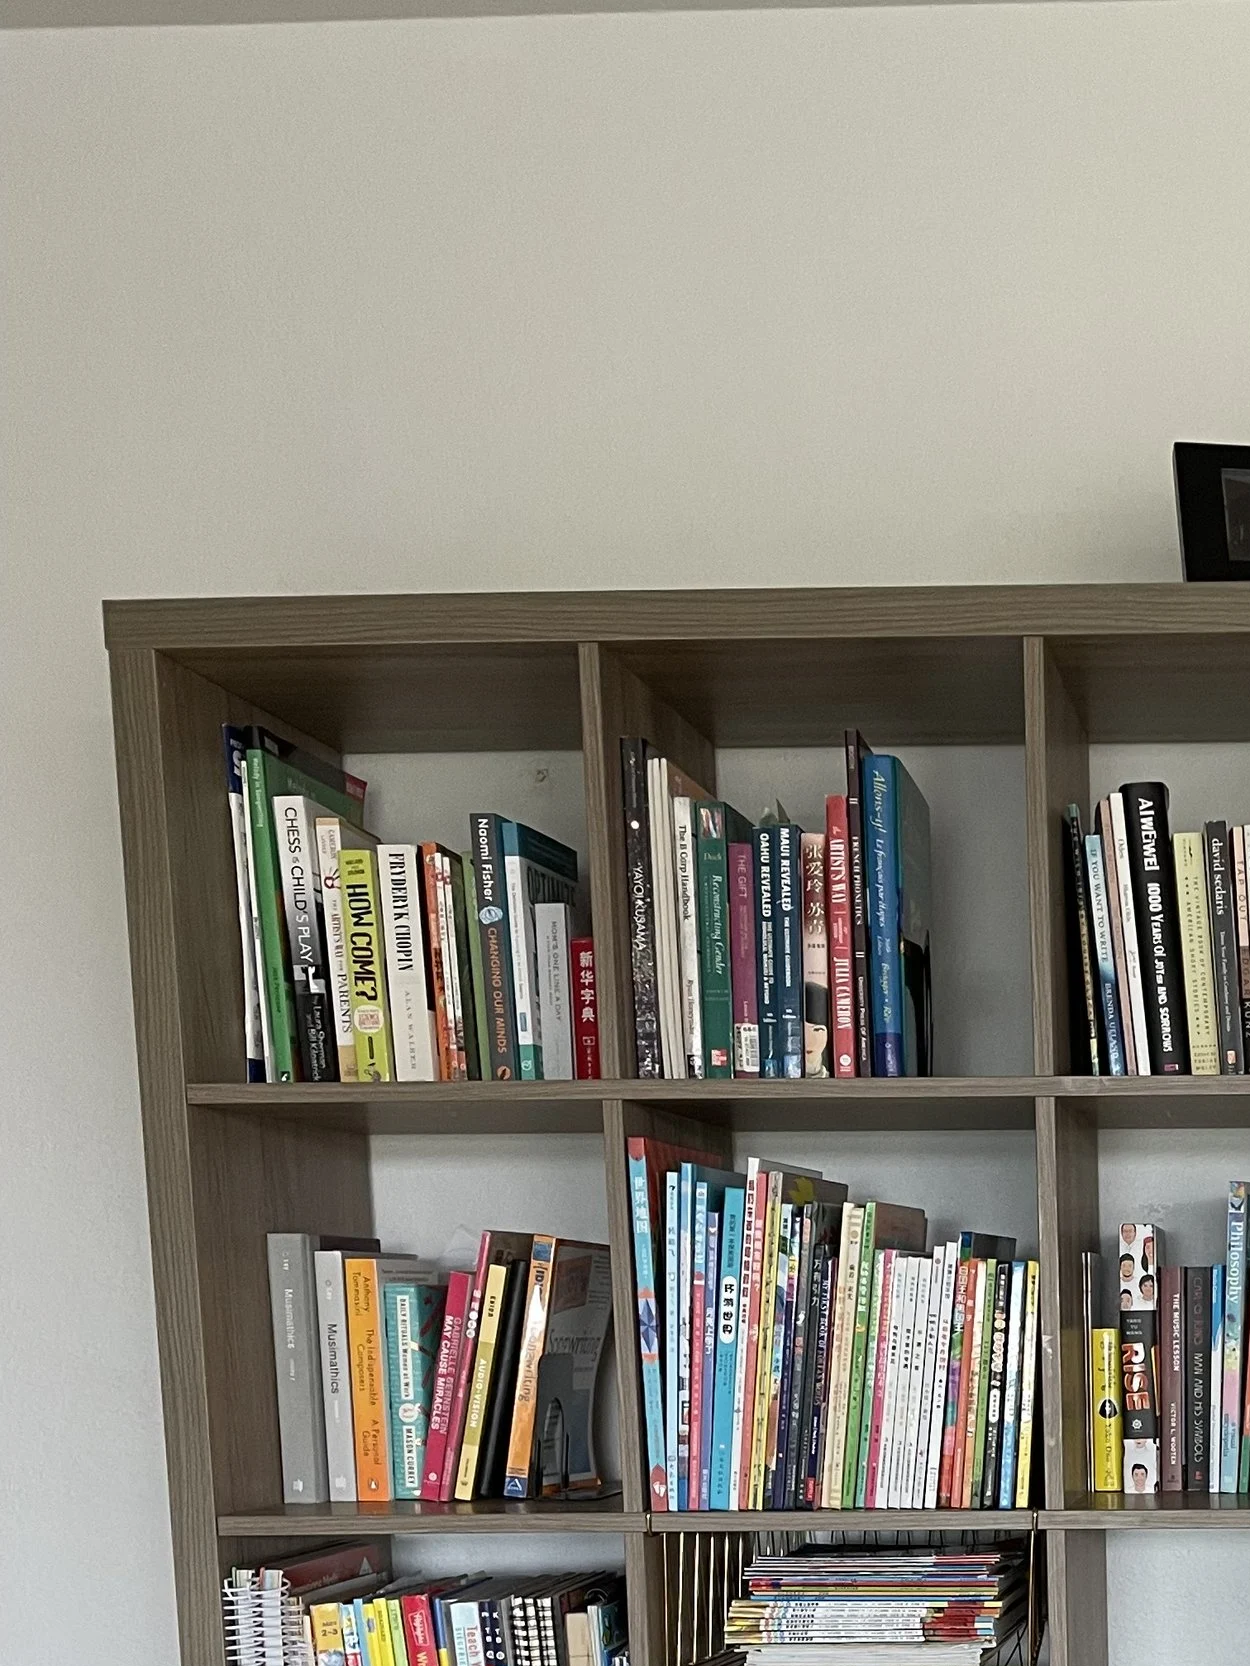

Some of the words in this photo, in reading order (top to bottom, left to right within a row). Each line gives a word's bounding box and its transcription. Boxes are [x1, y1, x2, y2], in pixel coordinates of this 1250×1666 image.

[285, 808, 301, 853] CHESS
[478, 819, 492, 860] Naomi
[760, 833, 770, 863] OAHU
[779, 828, 790, 856] MAUI
[830, 838, 845, 881] ARTIST'S
[1211, 839, 1226, 871] david
[291, 865, 309, 922] CHILD'S
[389, 853, 409, 920] FRYDERYK
[481, 864, 493, 901] Fisher
[761, 866, 771, 917] REVEALED
[781, 859, 793, 911] REVEALED
[832, 884, 846, 903] WAY
[1215, 874, 1227, 915] sedaris
[346, 884, 375, 926] HOW
[298, 926, 314, 962] PLAY
[396, 925, 413, 971] CHOPIN
[487, 928, 500, 987] CHANGING
[351, 932, 377, 1000] COME?
[580, 951, 594, 1022] 新华字典
[834, 957, 850, 982] JULIA
[337, 973, 353, 1033] PARENTS
[493, 991, 504, 1014] OUR
[836, 985, 852, 1029] CAMERON
[496, 1017, 506, 1053] MINDS
[1227, 1221, 1244, 1304] Philosophy
[442, 1315, 453, 1338] MAY
[327, 1324, 340, 1393] Musimathics
[437, 1341, 451, 1375] CAUSE
[1121, 1342, 1150, 1410] RISE
[1194, 1353, 1203, 1375] MAN
[431, 1377, 446, 1430] MIRACLES
[469, 1358, 487, 1428] AUDIO-VISION
[1194, 1378, 1203, 1398] AND
[1194, 1401, 1203, 1416] HIS
[405, 1428, 414, 1454] MASON
[1194, 1420, 1203, 1463] SYMBOLS
[407, 1456, 416, 1484] CURREY
[467, 1625, 480, 1658] Teach
